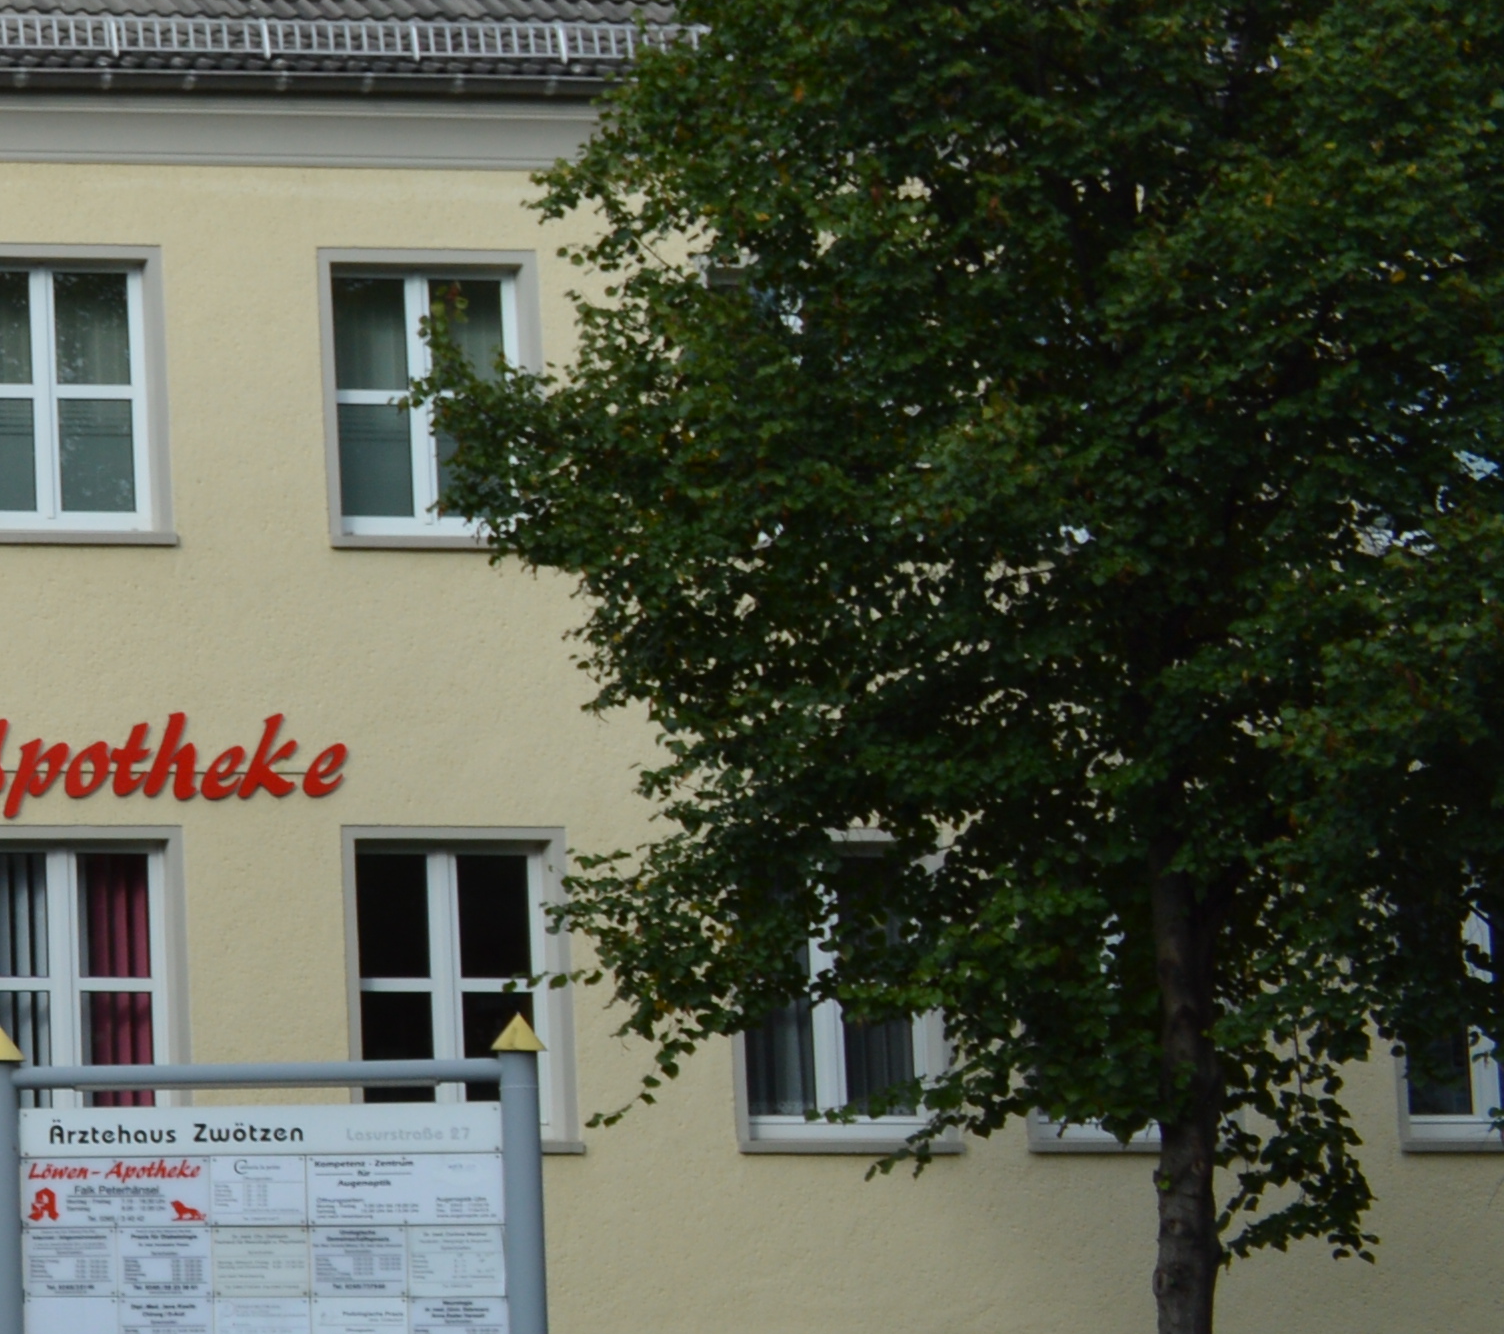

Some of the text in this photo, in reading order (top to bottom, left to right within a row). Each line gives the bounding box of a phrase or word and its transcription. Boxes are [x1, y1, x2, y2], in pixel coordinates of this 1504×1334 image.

[49, 1119, 471, 1145] Ärztehaus Zwötzen Lasurstraße 27
[314, 1160, 366, 1169] Kompetenz
[337, 1180, 392, 1188] Augenoptik
[74, 1185, 160, 1195] Falk Peterhänsel
